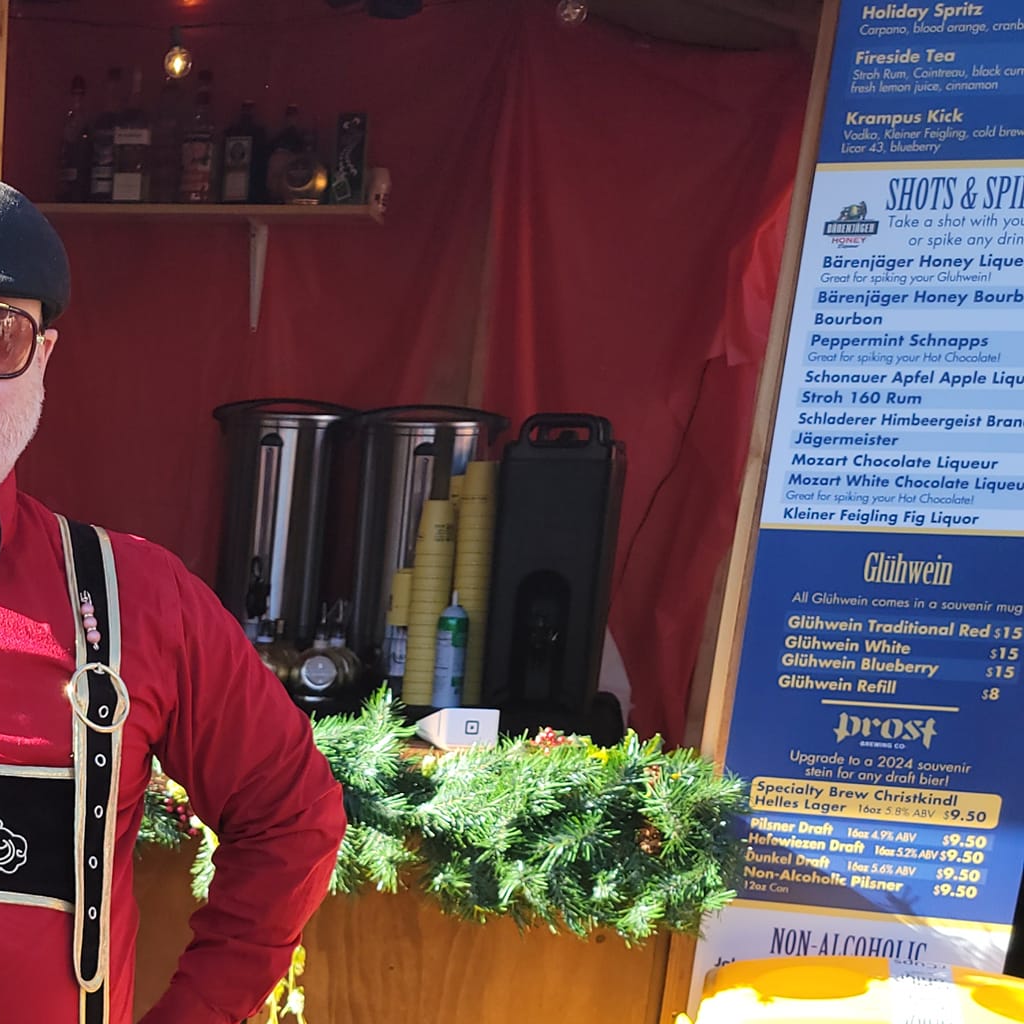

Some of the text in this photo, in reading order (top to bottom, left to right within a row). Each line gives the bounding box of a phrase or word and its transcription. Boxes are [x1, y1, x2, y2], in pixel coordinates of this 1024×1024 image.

[862, 2, 984, 21] Holiday Spritz
[913, 22, 944, 33] blood
[947, 23, 989, 35] orange,
[856, 48, 955, 65] Fireside Tea
[853, 65, 1000, 80] Stroh Rum, Cointreau, black
[851, 82, 998, 94] fresh lemon juice, cinnamon
[846, 108, 964, 128] Krampus Kick
[844, 126, 995, 141] Vodka, Kleiner Feigling, cold
[841, 143, 866, 153] Licor
[891, 141, 941, 153] blueberry
[886, 176, 978, 211] SHOTS &
[888, 214, 997, 228] Take a shot with
[909, 234, 992, 249] or spike any
[823, 255, 974, 272] Bärenjäger Honey
[821, 273, 850, 283] Great
[853, 272, 866, 283] for
[870, 272, 906, 285] spiking
[910, 274, 933, 285] your
[818, 290, 968, 307] Bärenjäger Honey
[814, 313, 883, 327] Bourbon
[811, 333, 989, 350] Peppermint Schnapps
[805, 370, 987, 387] Schonauer Apfel Apple
[801, 391, 922, 405] Stroh 160 Rum
[798, 413, 982, 430] Schladerer Himbeergeist
[795, 432, 899, 448] Jägermeister
[792, 454, 999, 472] Mozart Chocolate Liqueur
[788, 474, 969, 489] Mozart White Chocolate
[783, 507, 979, 527] Kleiner Feigling Fig Liquor
[863, 551, 953, 585] Glühwein
[792, 592, 992, 611] All Glühwein comes in a souvenir
[788, 615, 1023, 640] Glühwein Traditional Red $15
[785, 635, 1019, 660] Glühwein White $15
[782, 653, 1015, 679] Glühwein Blueberry $15
[778, 675, 1000, 700] Glühwein Refill $8
[833, 712, 937, 749] prost
[790, 750, 972, 773] Upgrade to a 2024 souvenir
[805, 767, 949, 787] stein for any draft bier!
[757, 781, 958, 806] Specialty Brew Christkindl
[754, 795, 799, 808] Helles
[804, 800, 847, 813] Lager
[858, 804, 881, 814] 16oz
[913, 808, 936, 818] ABV
[943, 810, 986, 822] $9.50
[750, 818, 987, 849] Pilsner Draft $9.50
[829, 842, 865, 854] Draft
[940, 849, 984, 864] $9.50
[745, 851, 980, 882] Dunkel Draft $9.50
[744, 866, 977, 899] Non-Alcoholic Pilsner $9.50
